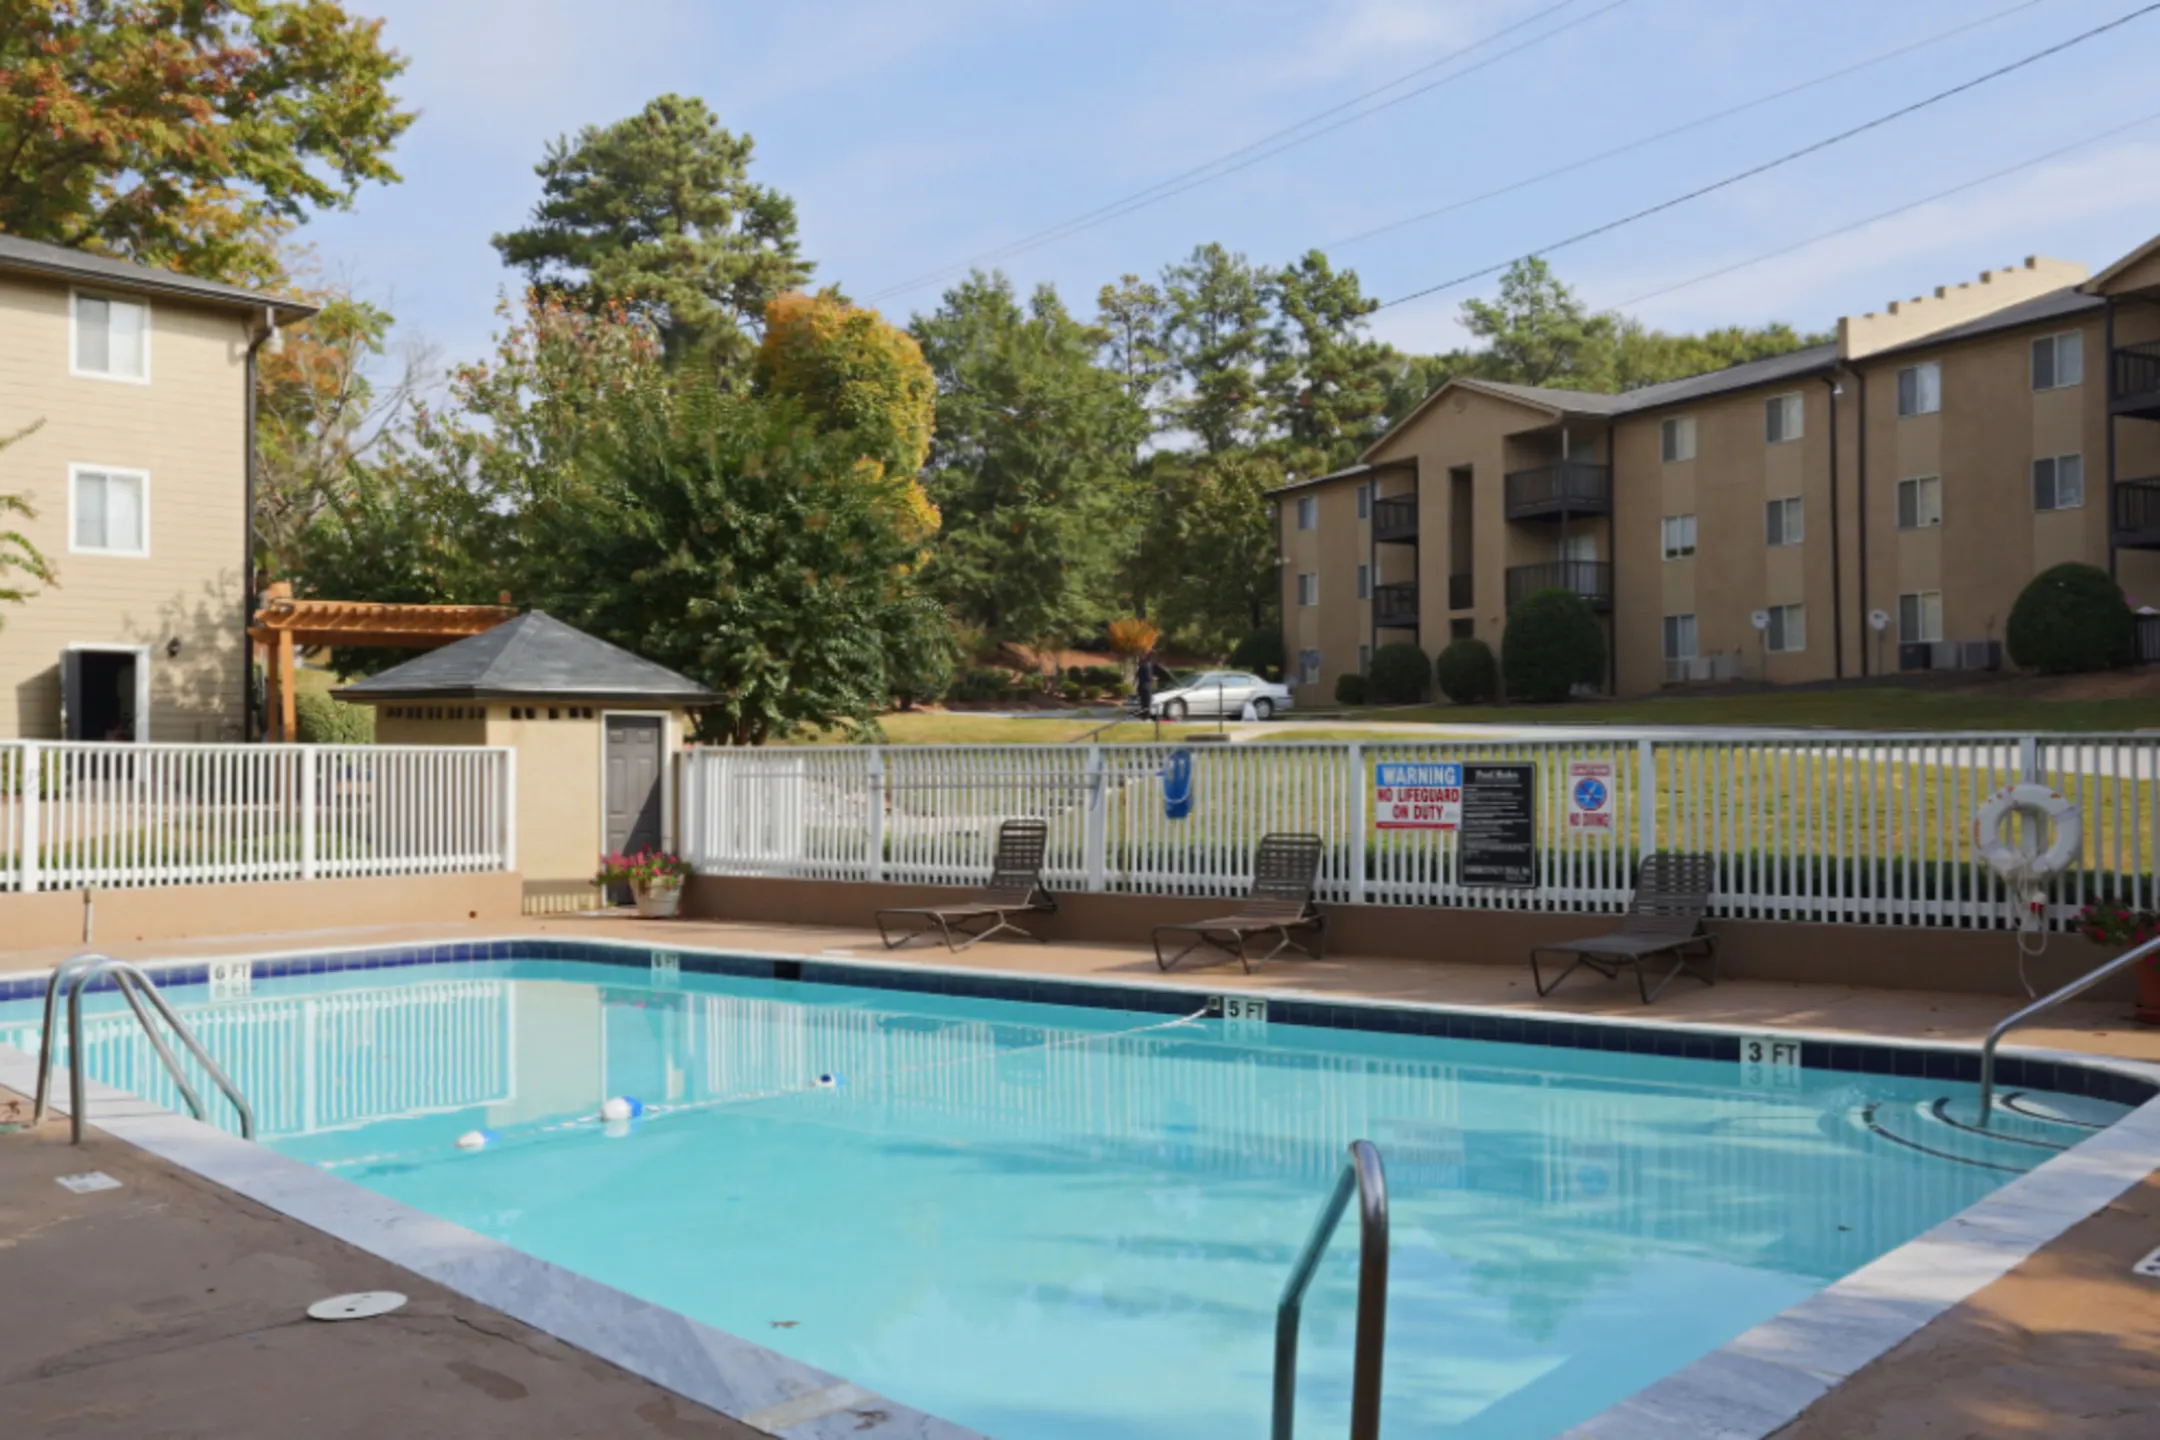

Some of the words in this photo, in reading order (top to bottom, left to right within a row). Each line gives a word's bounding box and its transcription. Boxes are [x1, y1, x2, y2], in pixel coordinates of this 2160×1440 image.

[1383, 766, 1456, 785] WARNING
[1377, 788, 1393, 802] NO
[1398, 788, 1460, 804] LIFEGUARD
[1393, 804, 1409, 819] ON
[1414, 804, 1444, 820] DUTY
[214, 964, 226, 980] 6
[231, 963, 249, 979] FT
[1229, 1000, 1241, 1018] 5
[1246, 1002, 1265, 1020] FT
[1748, 1041, 1762, 1063] 3
[1772, 1042, 1798, 1066] FT
